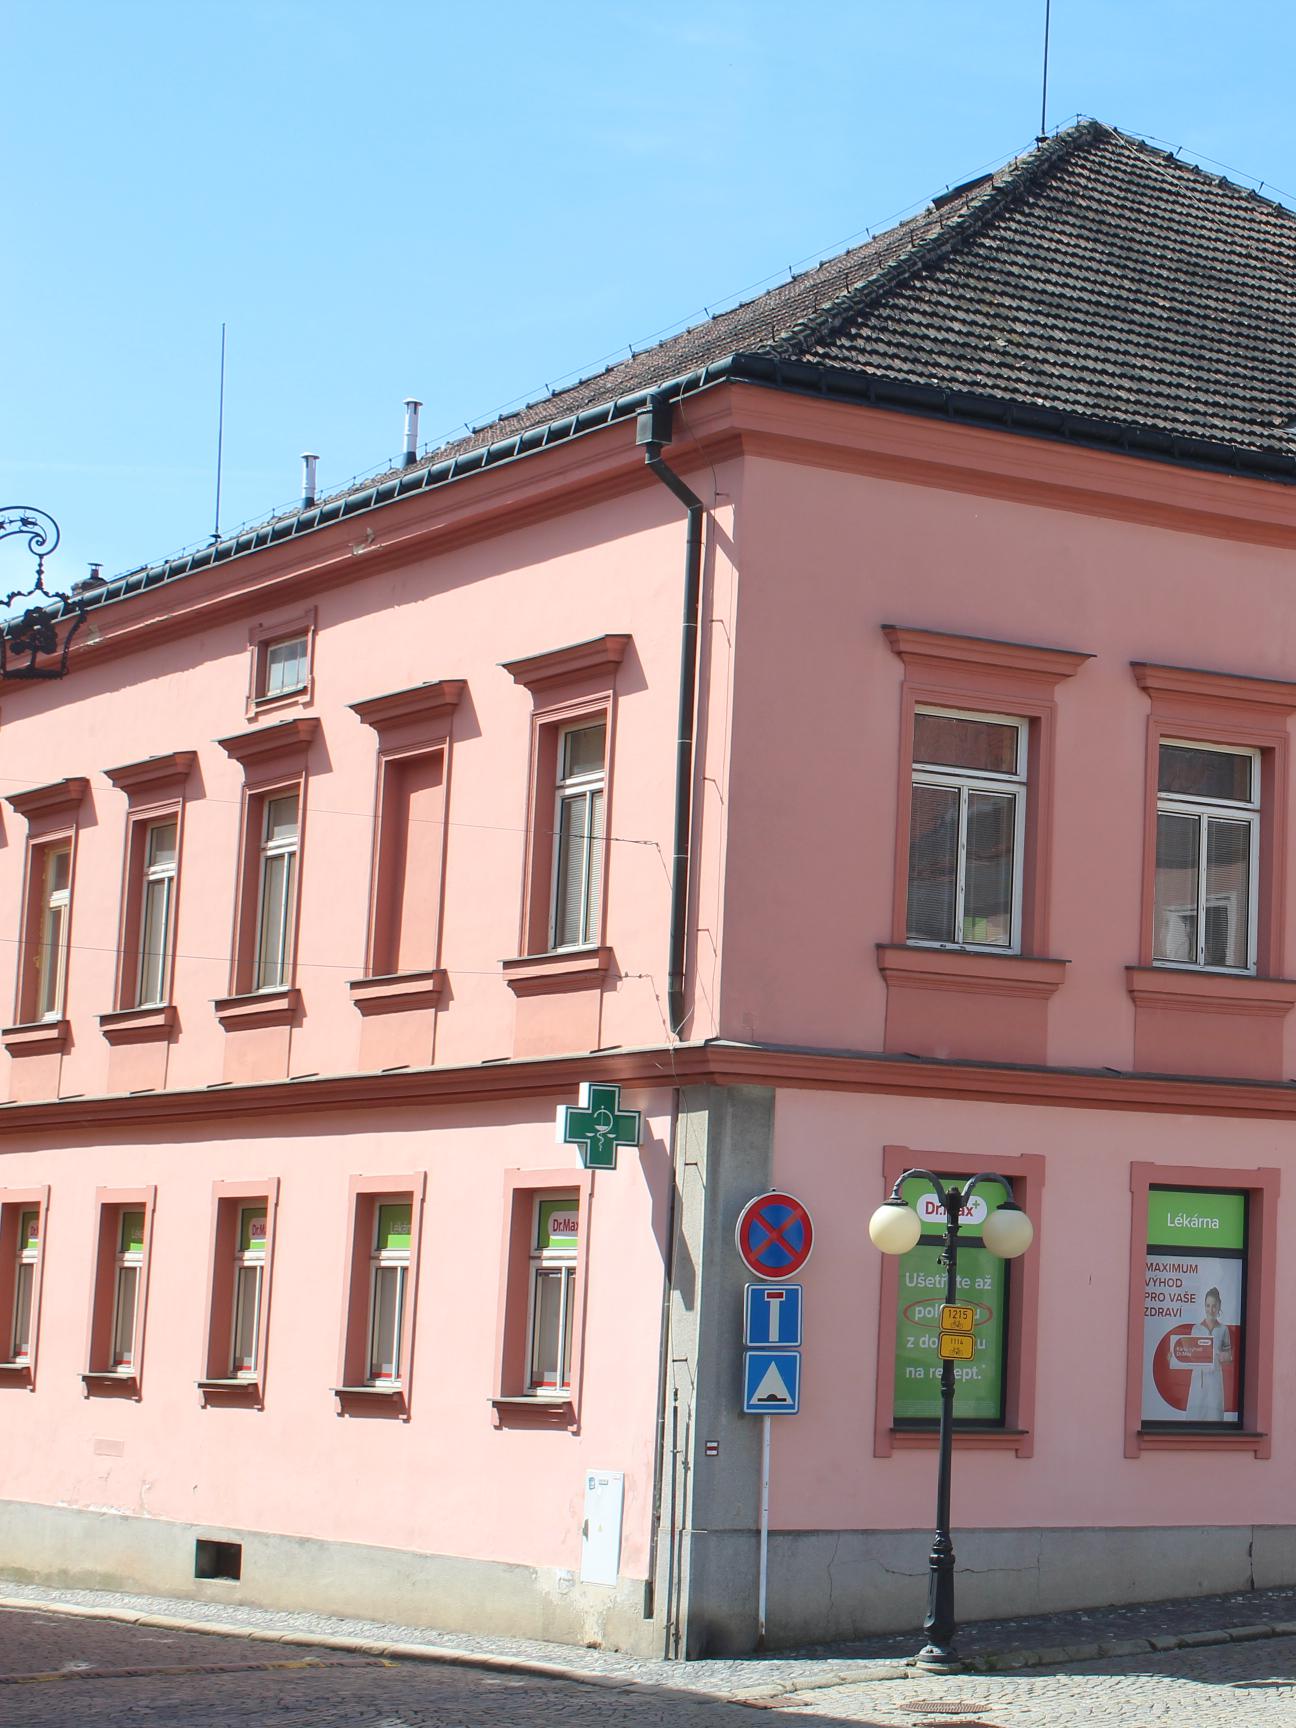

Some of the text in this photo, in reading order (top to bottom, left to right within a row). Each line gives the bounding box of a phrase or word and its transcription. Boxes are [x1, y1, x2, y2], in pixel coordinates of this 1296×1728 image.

[1167, 1210, 1220, 1229] Lékárna
[1145, 1262, 1199, 1274] MAXIMUM
[905, 1272, 992, 1289] Ušetřte až
[1145, 1275, 1183, 1288] VÝHOD
[1144, 1290, 1197, 1304] PRO VAŠE
[948, 1309, 968, 1320] 1215
[1144, 1305, 1182, 1318] ZDRAVÍ
[906, 1366, 924, 1378] na
